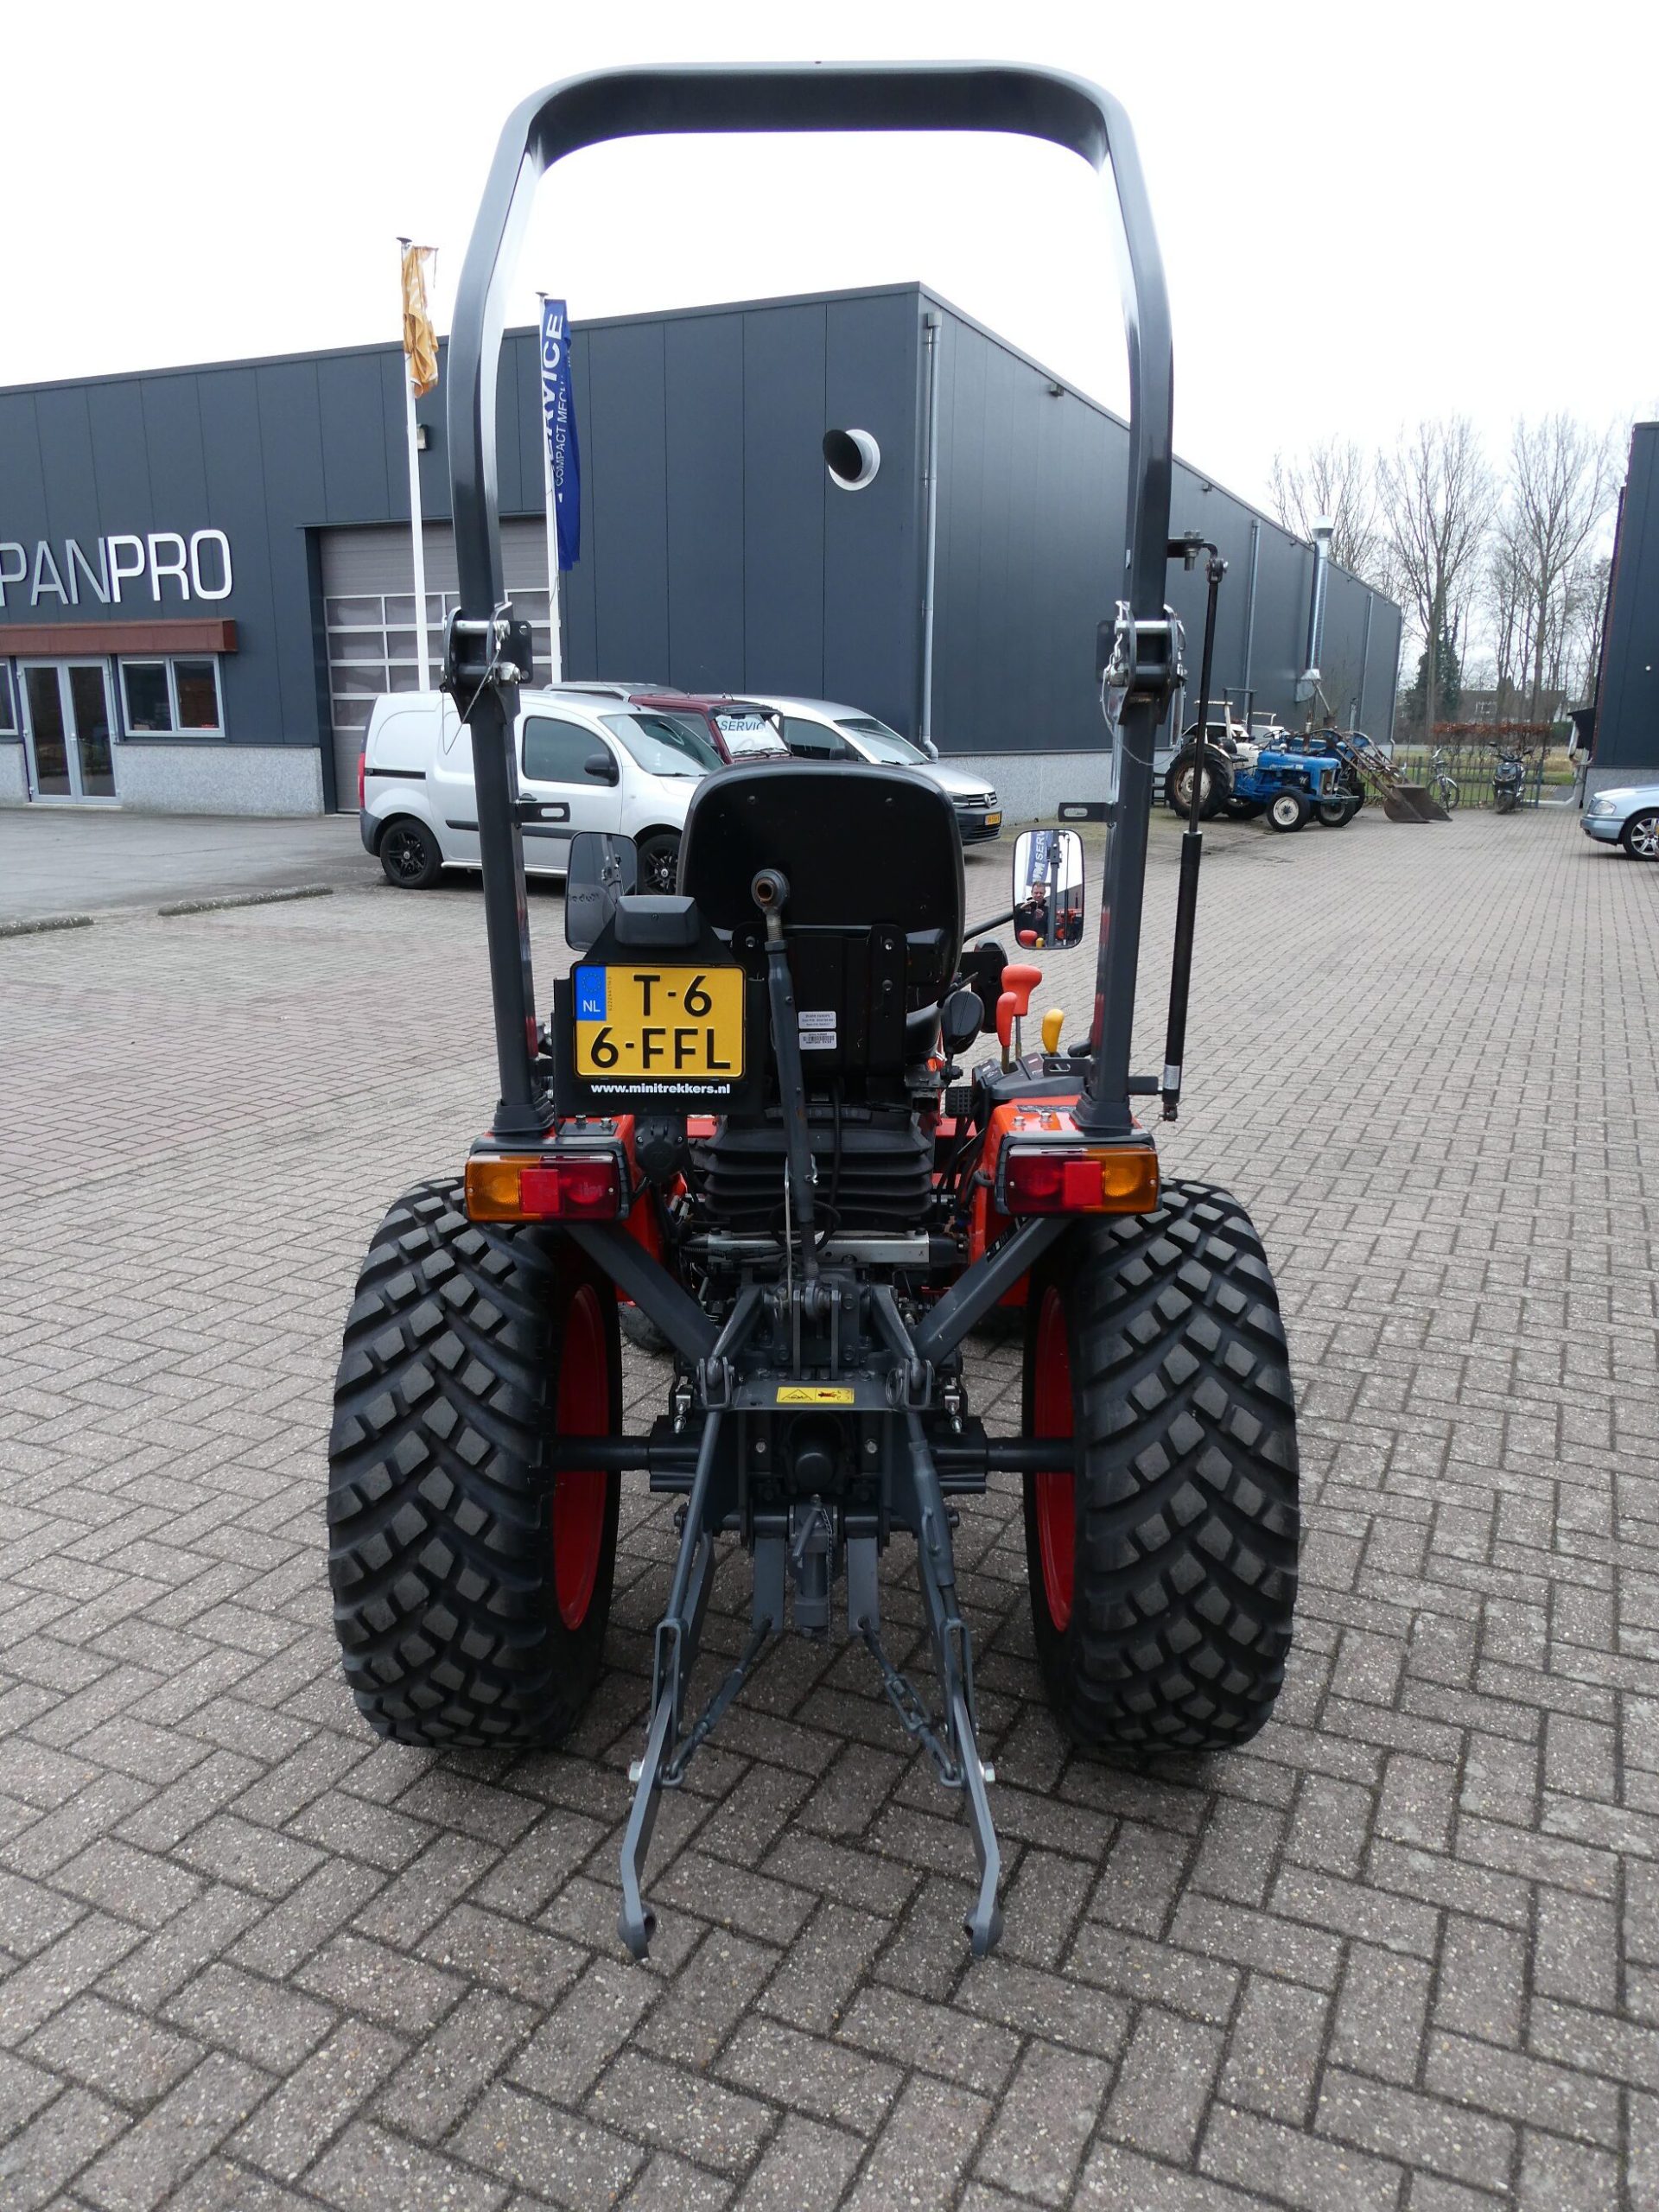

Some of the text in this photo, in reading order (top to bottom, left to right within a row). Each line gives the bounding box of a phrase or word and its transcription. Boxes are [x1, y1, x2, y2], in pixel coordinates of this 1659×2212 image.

[556, 424, 566, 486] COMPACT
[582, 1000, 601, 1013] NL
[633, 974, 712, 1018] T-6
[591, 1027, 731, 1070] 6-FFL
[591, 1083, 731, 1094] www.minitrekkers.nl
